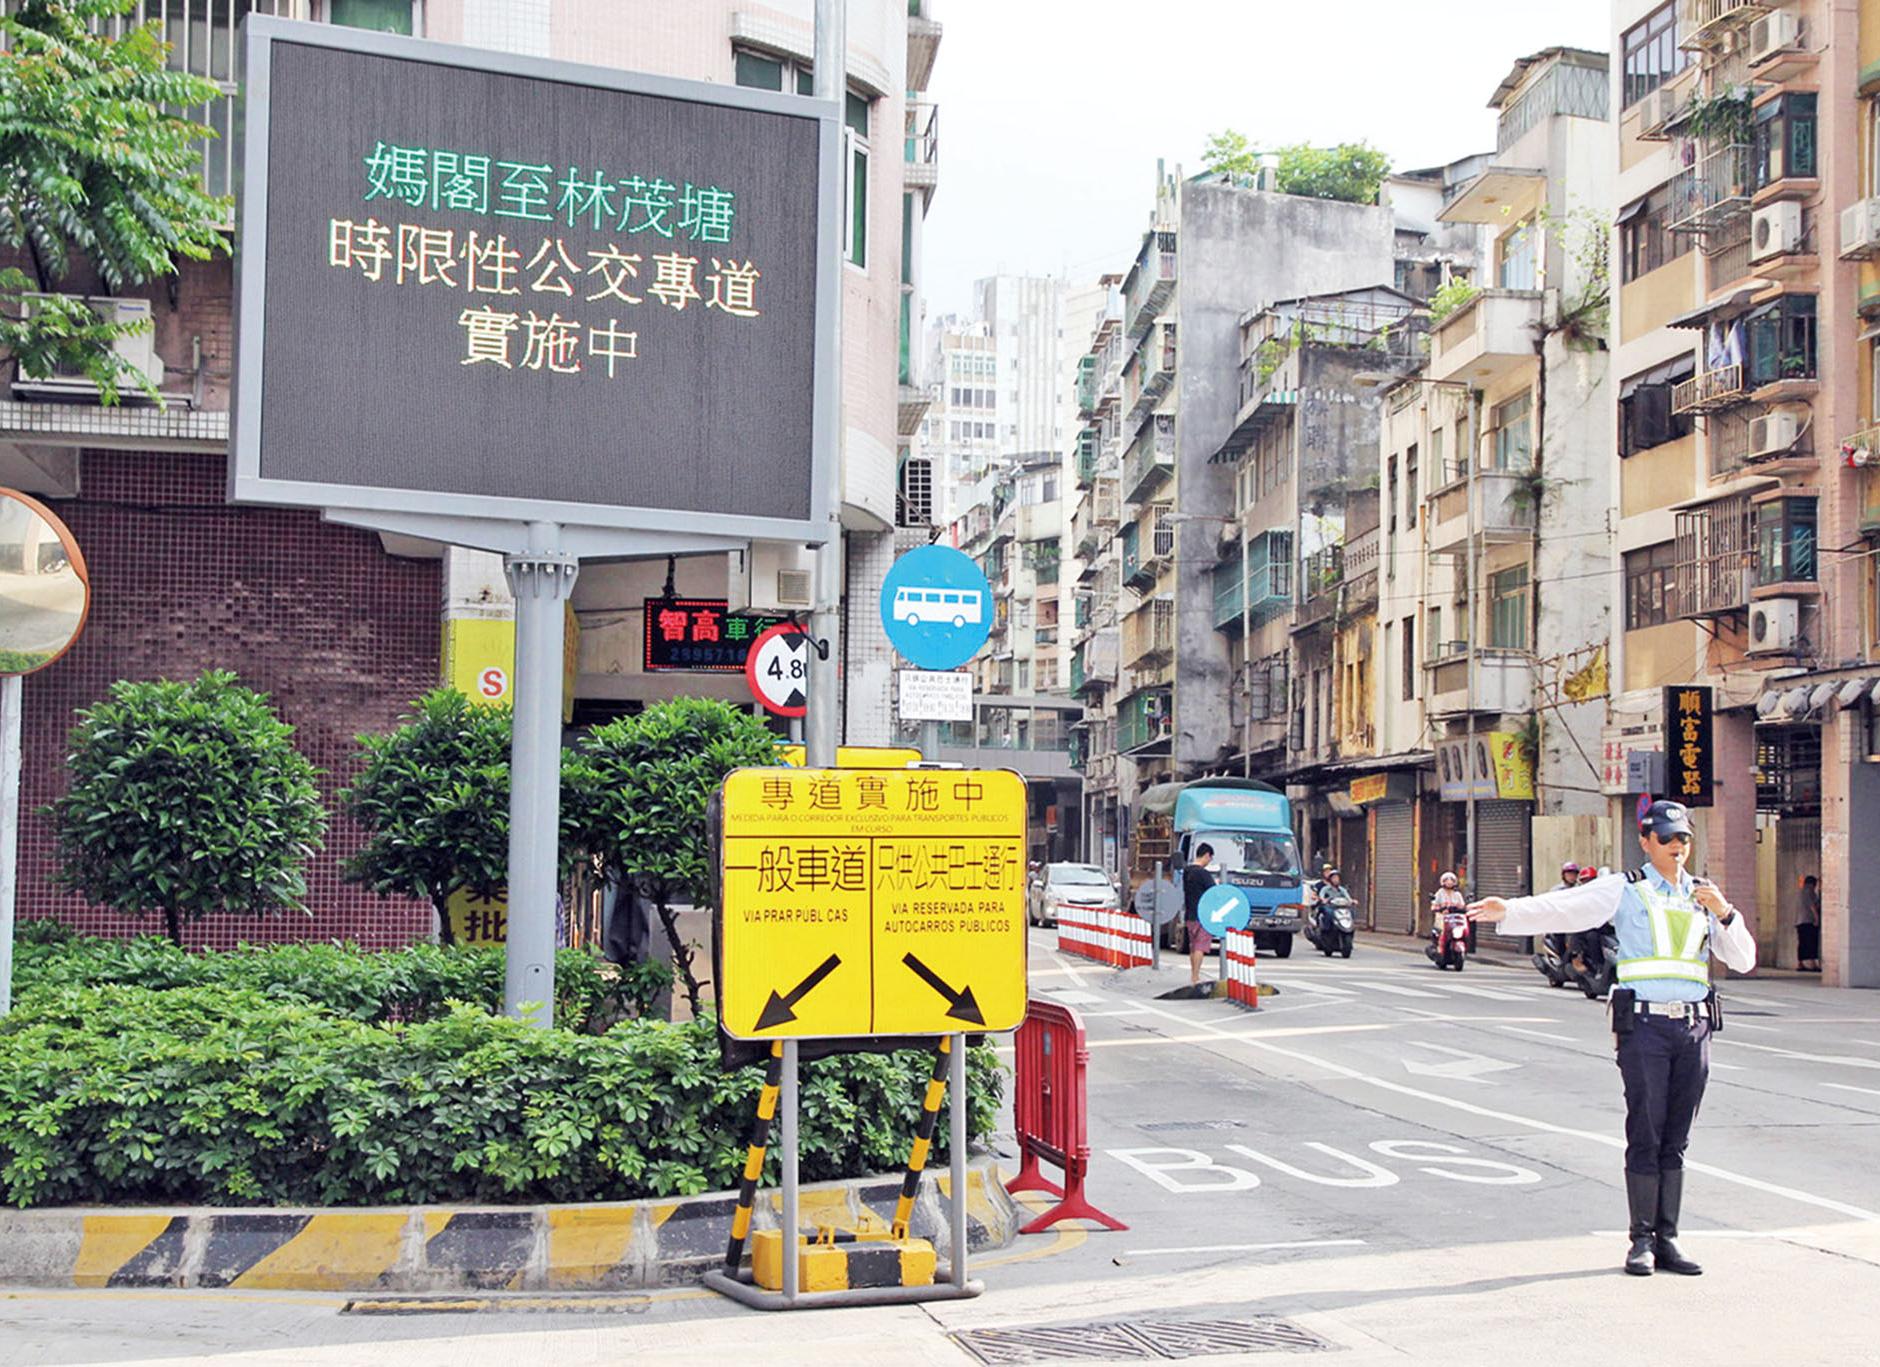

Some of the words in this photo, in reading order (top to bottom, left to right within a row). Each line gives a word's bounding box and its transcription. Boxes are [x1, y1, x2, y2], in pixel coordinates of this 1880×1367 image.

[364, 141, 735, 245] 媽閣至林茂塘
[328, 217, 762, 318] 時限性公交專道
[457, 304, 639, 379] 實施中
[482, 670, 503, 696] S
[767, 655, 808, 681] 4.8
[760, 775, 983, 812] 專道實施中
[767, 814, 789, 822] PARA
[799, 814, 844, 822] CORREDOR
[890, 814, 912, 822] PARA
[851, 825, 864, 833] EM
[865, 825, 893, 833] CURSO
[725, 845, 866, 892] 一般車道
[877, 845, 1018, 891] 只供公共巴士通行
[743, 908, 761, 922] VIA
[892, 902, 909, 914] VIA
[913, 902, 974, 915] RESERVADA
[978, 901, 1005, 913] PARA
[884, 920, 955, 933] AUTOCARROS
[1104, 1139, 1542, 1193] BUS
